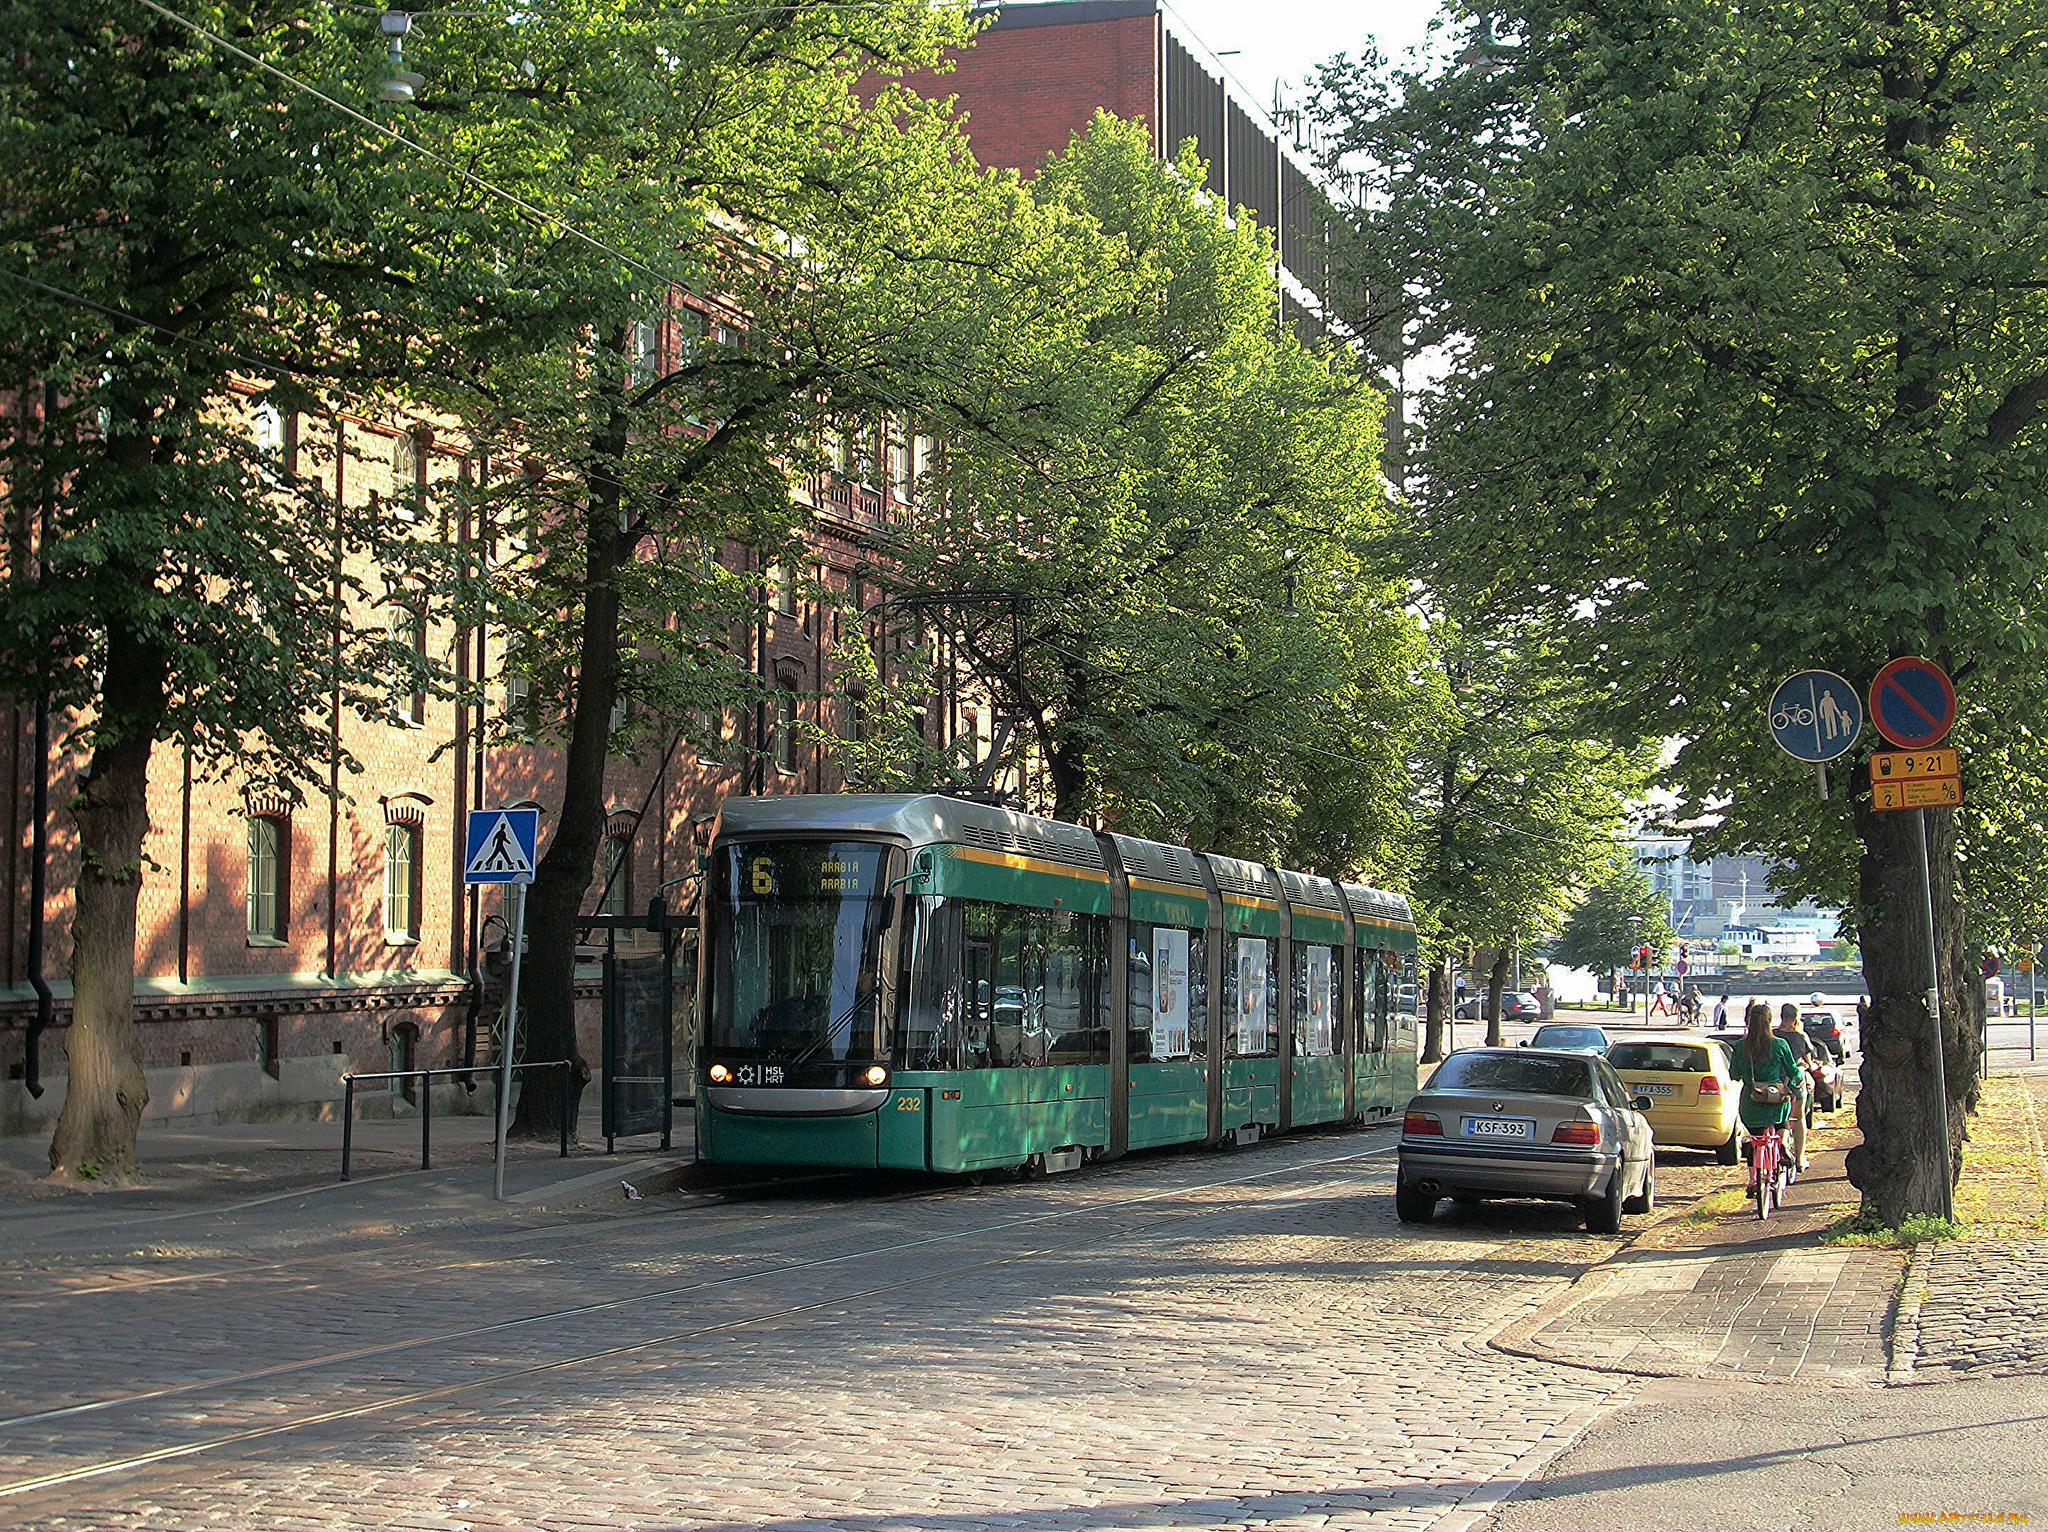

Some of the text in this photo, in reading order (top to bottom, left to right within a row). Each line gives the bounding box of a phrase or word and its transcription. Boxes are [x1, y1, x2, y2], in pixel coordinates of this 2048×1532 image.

[1905, 756, 1942, 772] 9-21
[1942, 782, 1957, 800] A/B
[1884, 794, 1893, 807] 2
[821, 861, 859, 873] ARABIA
[752, 857, 772, 894] 6
[821, 878, 859, 890] ARABIA
[765, 1066, 785, 1075] HSL
[765, 1074, 785, 1084] HRT
[1639, 1085, 1672, 1094] YFA-355
[897, 1097, 920, 1111] 232
[1476, 1121, 1525, 1135] KSF-393
